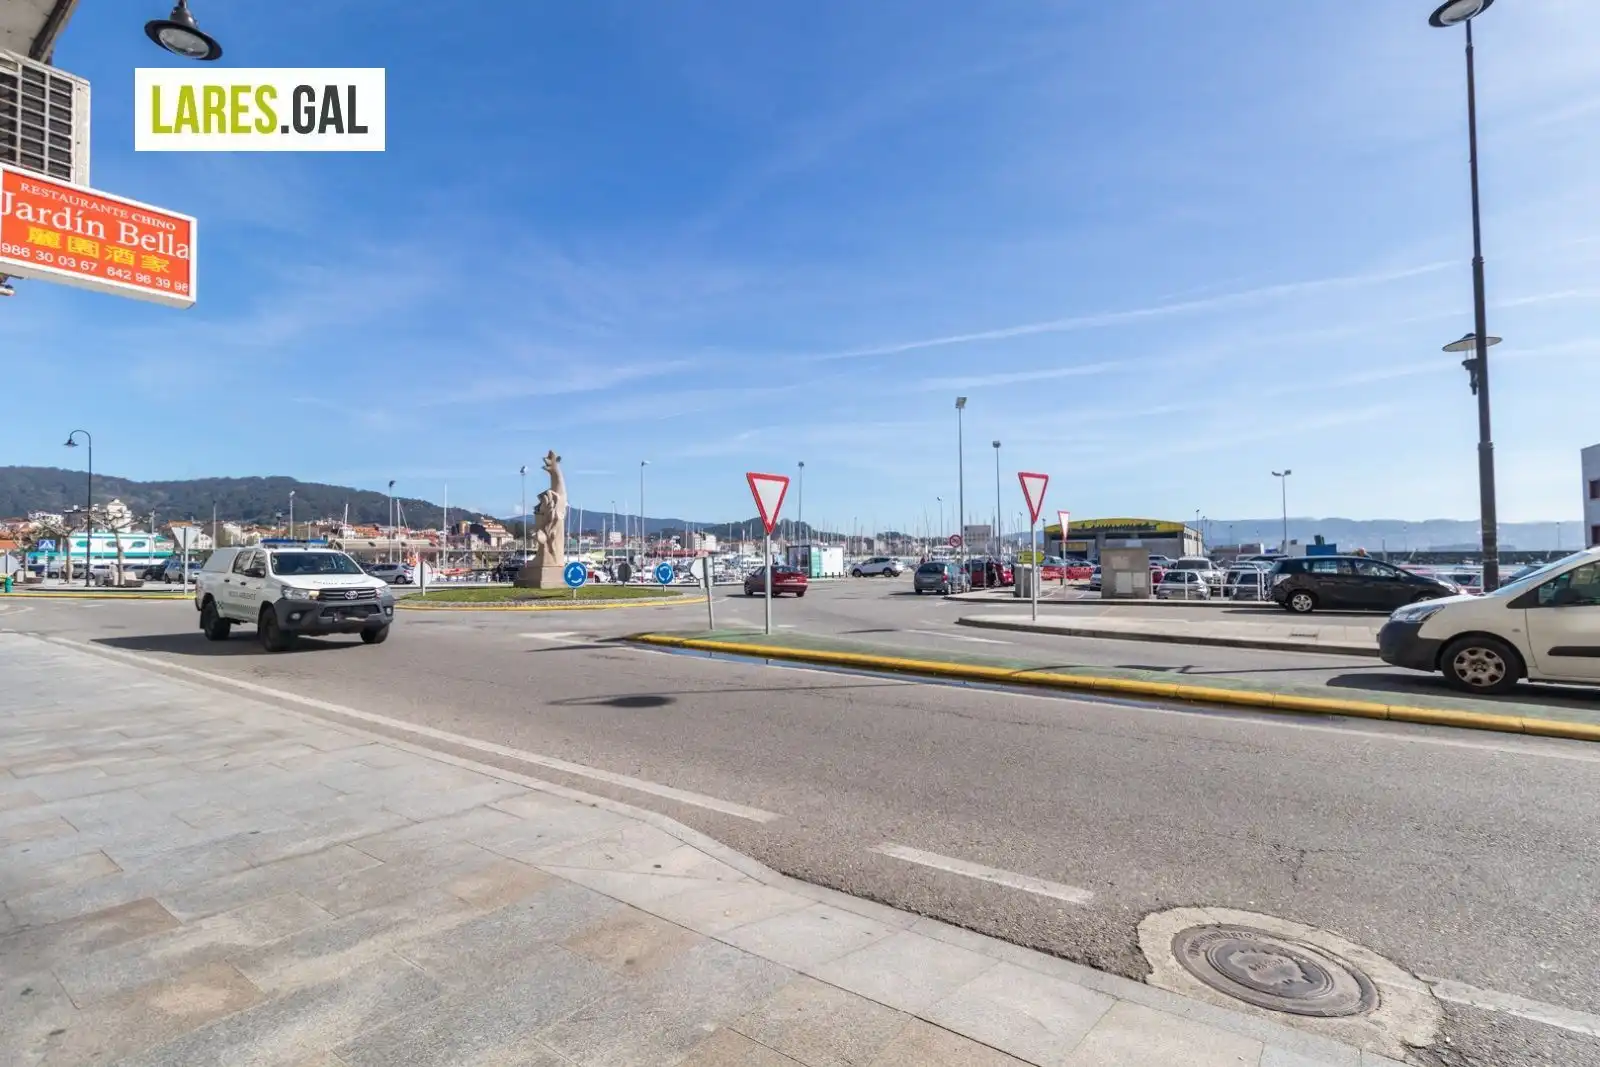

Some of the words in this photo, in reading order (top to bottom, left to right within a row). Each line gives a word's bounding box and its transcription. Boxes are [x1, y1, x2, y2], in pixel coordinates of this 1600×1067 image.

[0, 190, 106, 240] Jardín
[116, 220, 190, 260] Bella
[20, 182, 129, 219] RESTAURANTE
[131, 213, 177, 231] CHINO
[1, 243, 31, 258] 986
[35, 250, 54, 263] 30
[58, 255, 77, 268] 03
[80, 260, 98, 272] 67
[155, 276, 171, 289] 39
